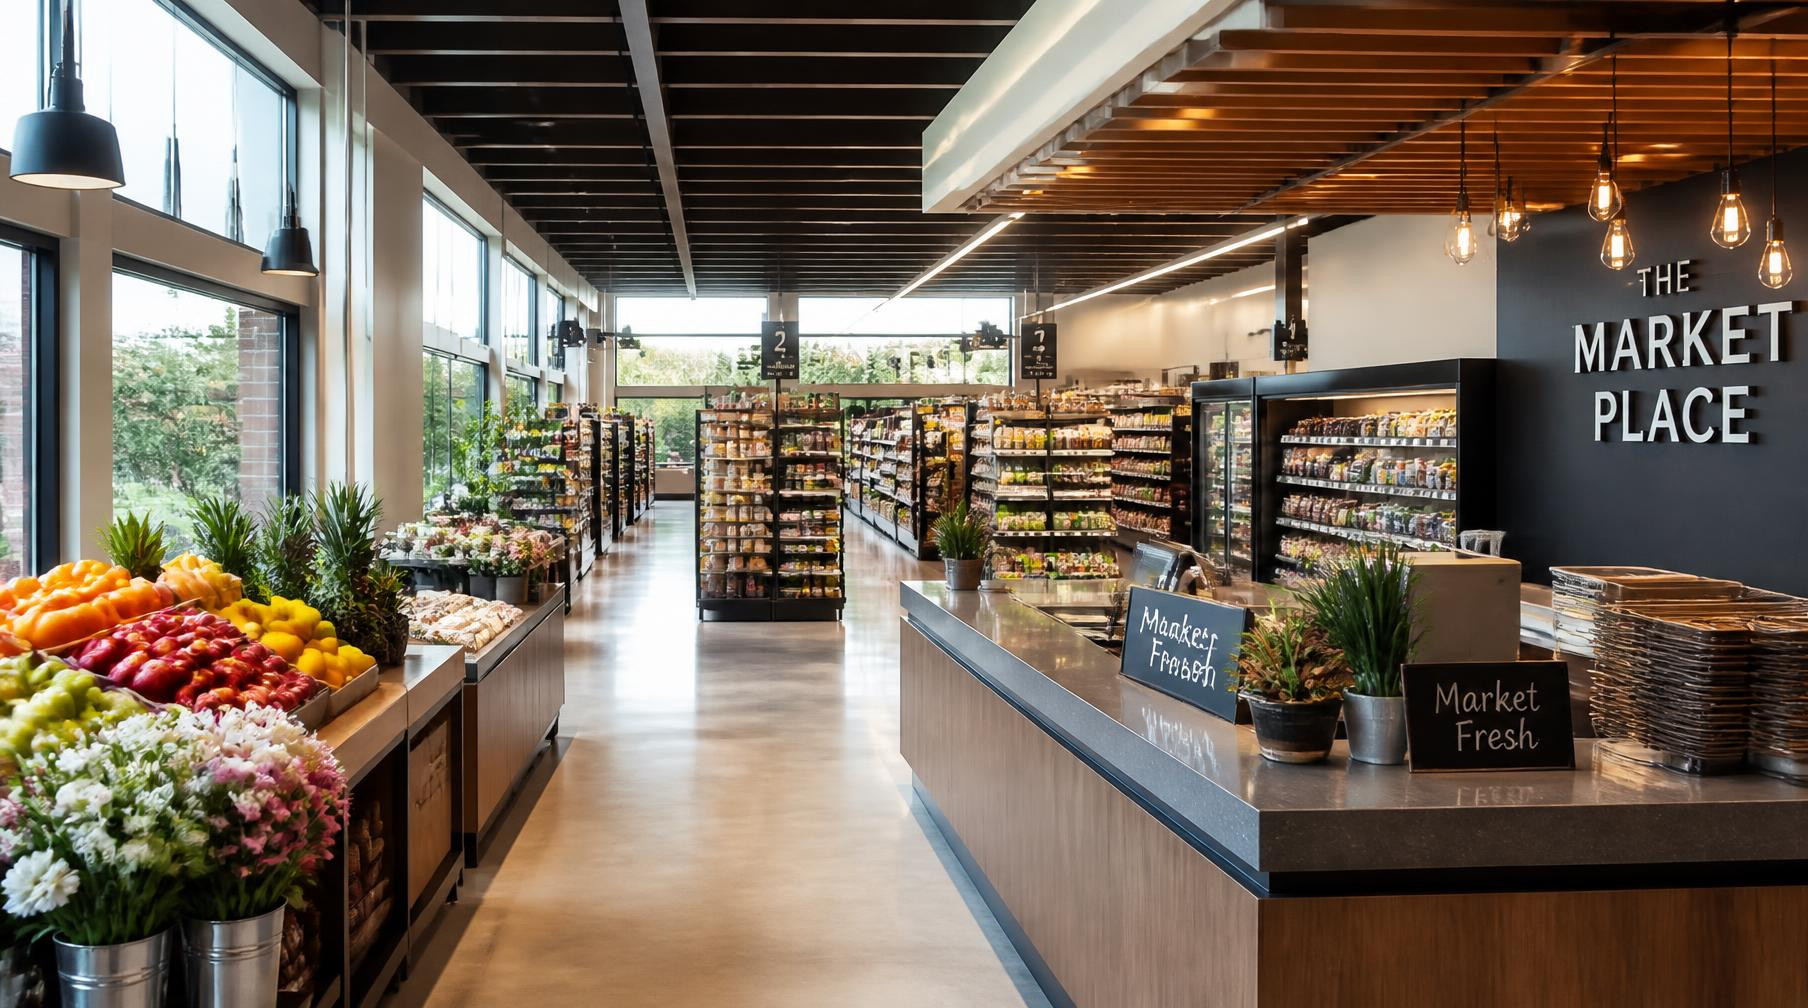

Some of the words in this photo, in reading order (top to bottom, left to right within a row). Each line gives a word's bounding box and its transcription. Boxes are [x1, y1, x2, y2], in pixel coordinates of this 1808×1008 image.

[1637, 259, 1690, 297] THE
[774, 330, 786, 352] 2
[1573, 300, 1793, 374] MARKET
[1594, 385, 1749, 444] PLACE
[1435, 679, 1541, 715] Market
[1456, 717, 1539, 751] Fresh
